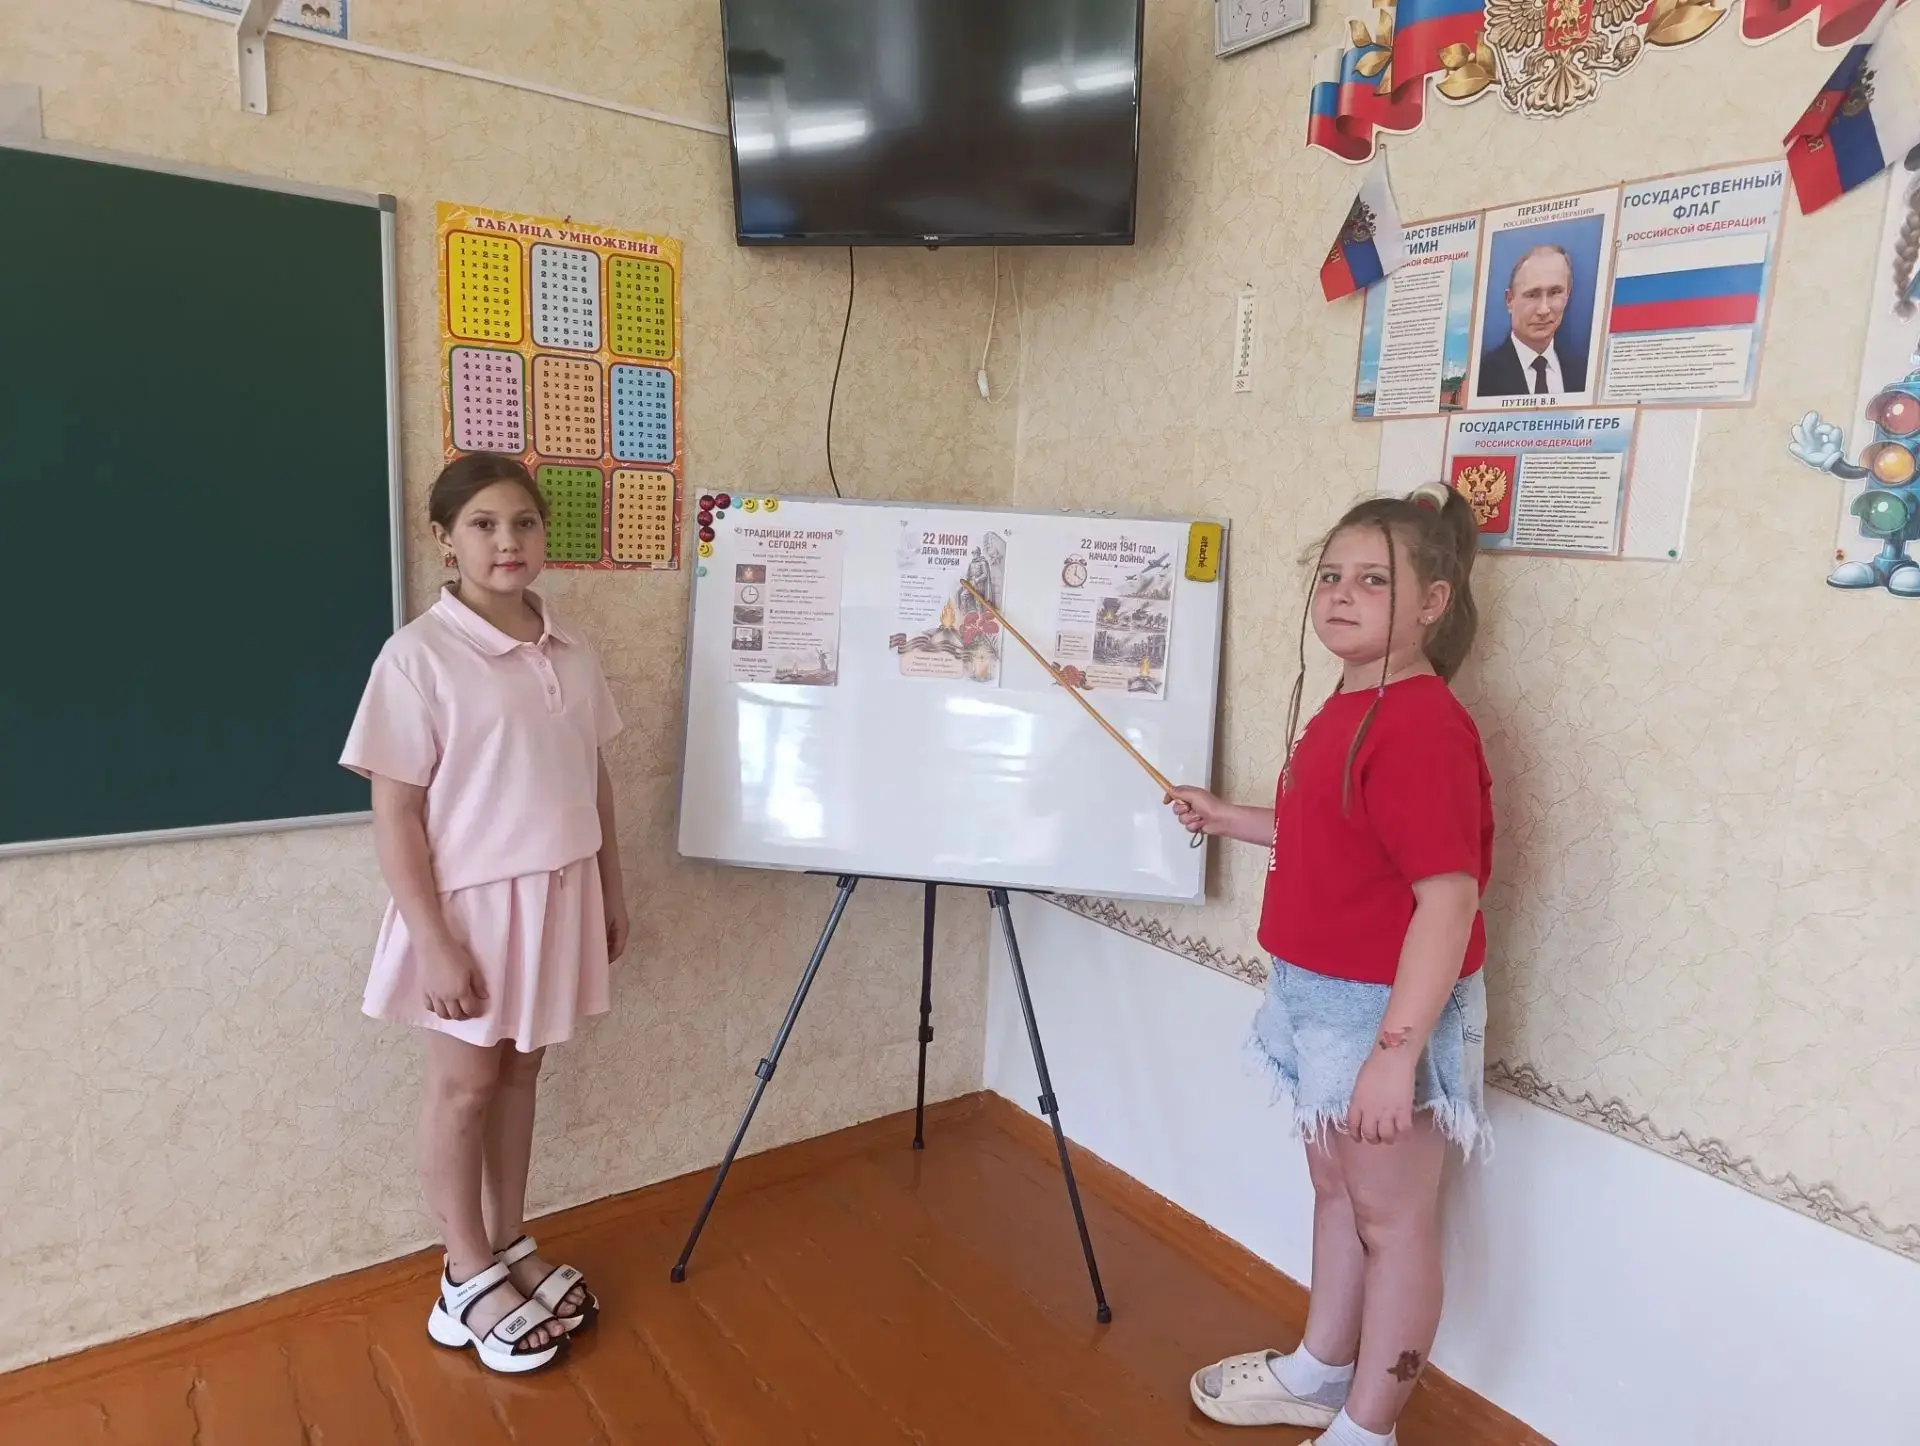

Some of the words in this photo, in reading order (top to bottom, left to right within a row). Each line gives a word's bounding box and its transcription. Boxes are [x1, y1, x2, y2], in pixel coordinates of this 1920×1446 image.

[1623, 170, 1783, 209] ГОСУДАРСТВЕННЫЙ
[1517, 197, 1581, 217] ПРЕЗИДЕНТ
[1672, 200, 1721, 220] ФЛАГ
[1404, 217, 1476, 241] АРСТВЕННЫЙ
[1626, 223, 1696, 242] РОССИЙСКОЙ
[1696, 216, 1766, 234] ФЕДЕРАЦИИ
[461, 236, 465, 244] 1
[483, 239, 488, 247] 1
[474, 217, 553, 239] ТАБЛИЦА
[558, 229, 659, 255] УМНОЖЕНИЯ
[1406, 240, 1439, 255] ИМН
[541, 248, 548, 256] 2
[563, 251, 568, 259] 1
[581, 254, 587, 262] 2
[1422, 251, 1469, 266] ФЕДЕРАЦИИ
[654, 265, 660, 273] 3
[483, 284, 489, 292] 5
[503, 287, 510, 295] 5
[541, 292, 548, 300] 2
[563, 295, 569, 303] 5
[582, 298, 593, 306] 10
[616, 302, 622, 310] 3
[484, 329, 490, 337] 9
[504, 331, 510, 339] 9
[654, 328, 665, 336] 21
[563, 338, 570, 346] 9
[1501, 397, 1538, 408] ПУТИН
[1540, 396, 1559, 407] В.В.
[464, 406, 471, 414] 4
[506, 410, 519, 418] 24
[583, 416, 596, 424] 30
[1459, 416, 1584, 435] ГОСУДАРСТВЕННЫЙ
[1586, 417, 1620, 431] ГЕРБ
[466, 439, 472, 447] 4
[507, 442, 520, 450] 36
[1474, 437, 1534, 449] РОССИЙСКОЙ
[1535, 437, 1593, 449] ФЕДЕРАЦИИ
[566, 446, 572, 454] 9
[744, 528, 791, 539] ТРАДИЦИИ
[793, 530, 804, 539] 22
[806, 531, 833, 540] ИЮНЯ
[922, 532, 936, 545] 22
[938, 534, 968, 547] ИЮНЯ
[768, 540, 808, 550] СЕГОДНЯ
[1080, 538, 1092, 550] 22
[1093, 540, 1117, 552] ИЮНЯ
[1119, 540, 1137, 552] 1941
[1138, 544, 1156, 554] ГОДА
[921, 546, 940, 556] ДЕНЬ
[940, 547, 968, 557] ПАМЯТИ
[1088, 551, 1118, 562] НАЧАЛО
[1119, 553, 1146, 564] ВОЙНЫ
[1197, 535, 1209, 569] attaché
[927, 556, 933, 565] И
[934, 557, 960, 566] СКОРБИ
